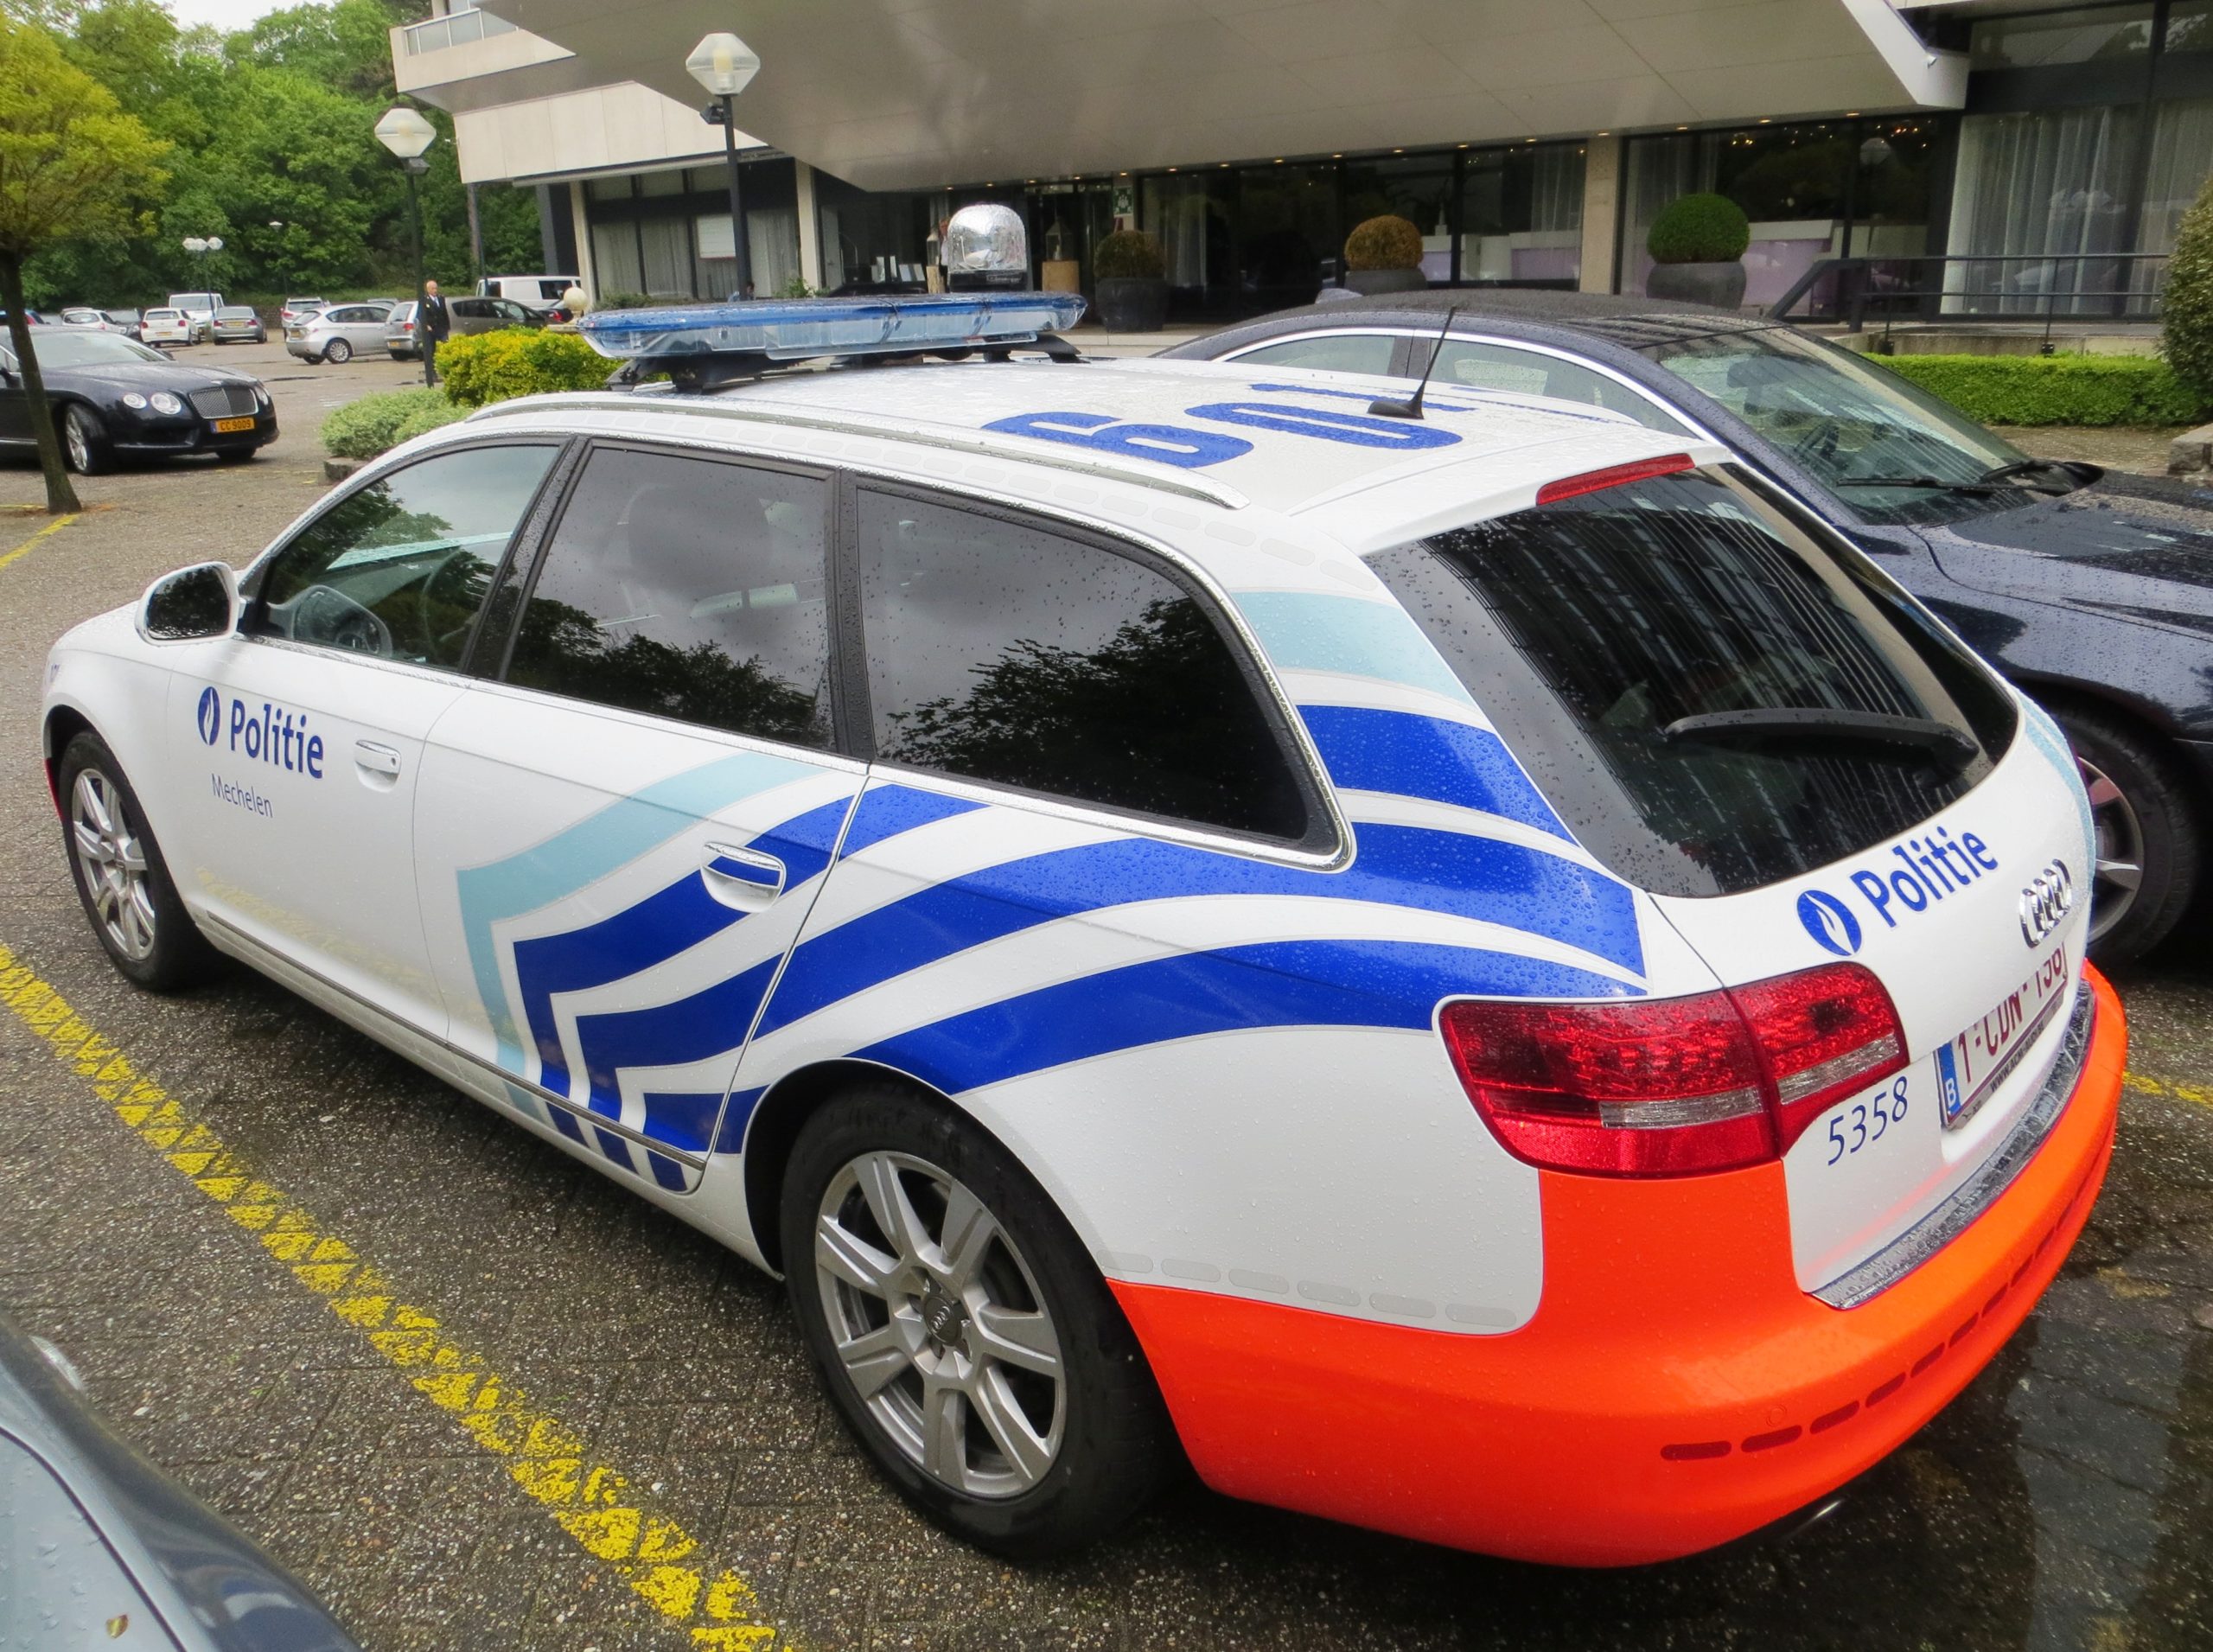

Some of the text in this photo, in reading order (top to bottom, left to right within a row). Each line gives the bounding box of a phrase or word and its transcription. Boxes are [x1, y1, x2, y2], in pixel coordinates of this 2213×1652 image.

[230, 698, 324, 780] Politie
[211, 773, 274, 819] Mechelen
[1849, 825, 1999, 928] Politie
[1828, 1075, 1909, 1166] 5358
[1945, 1077, 1957, 1108] B
